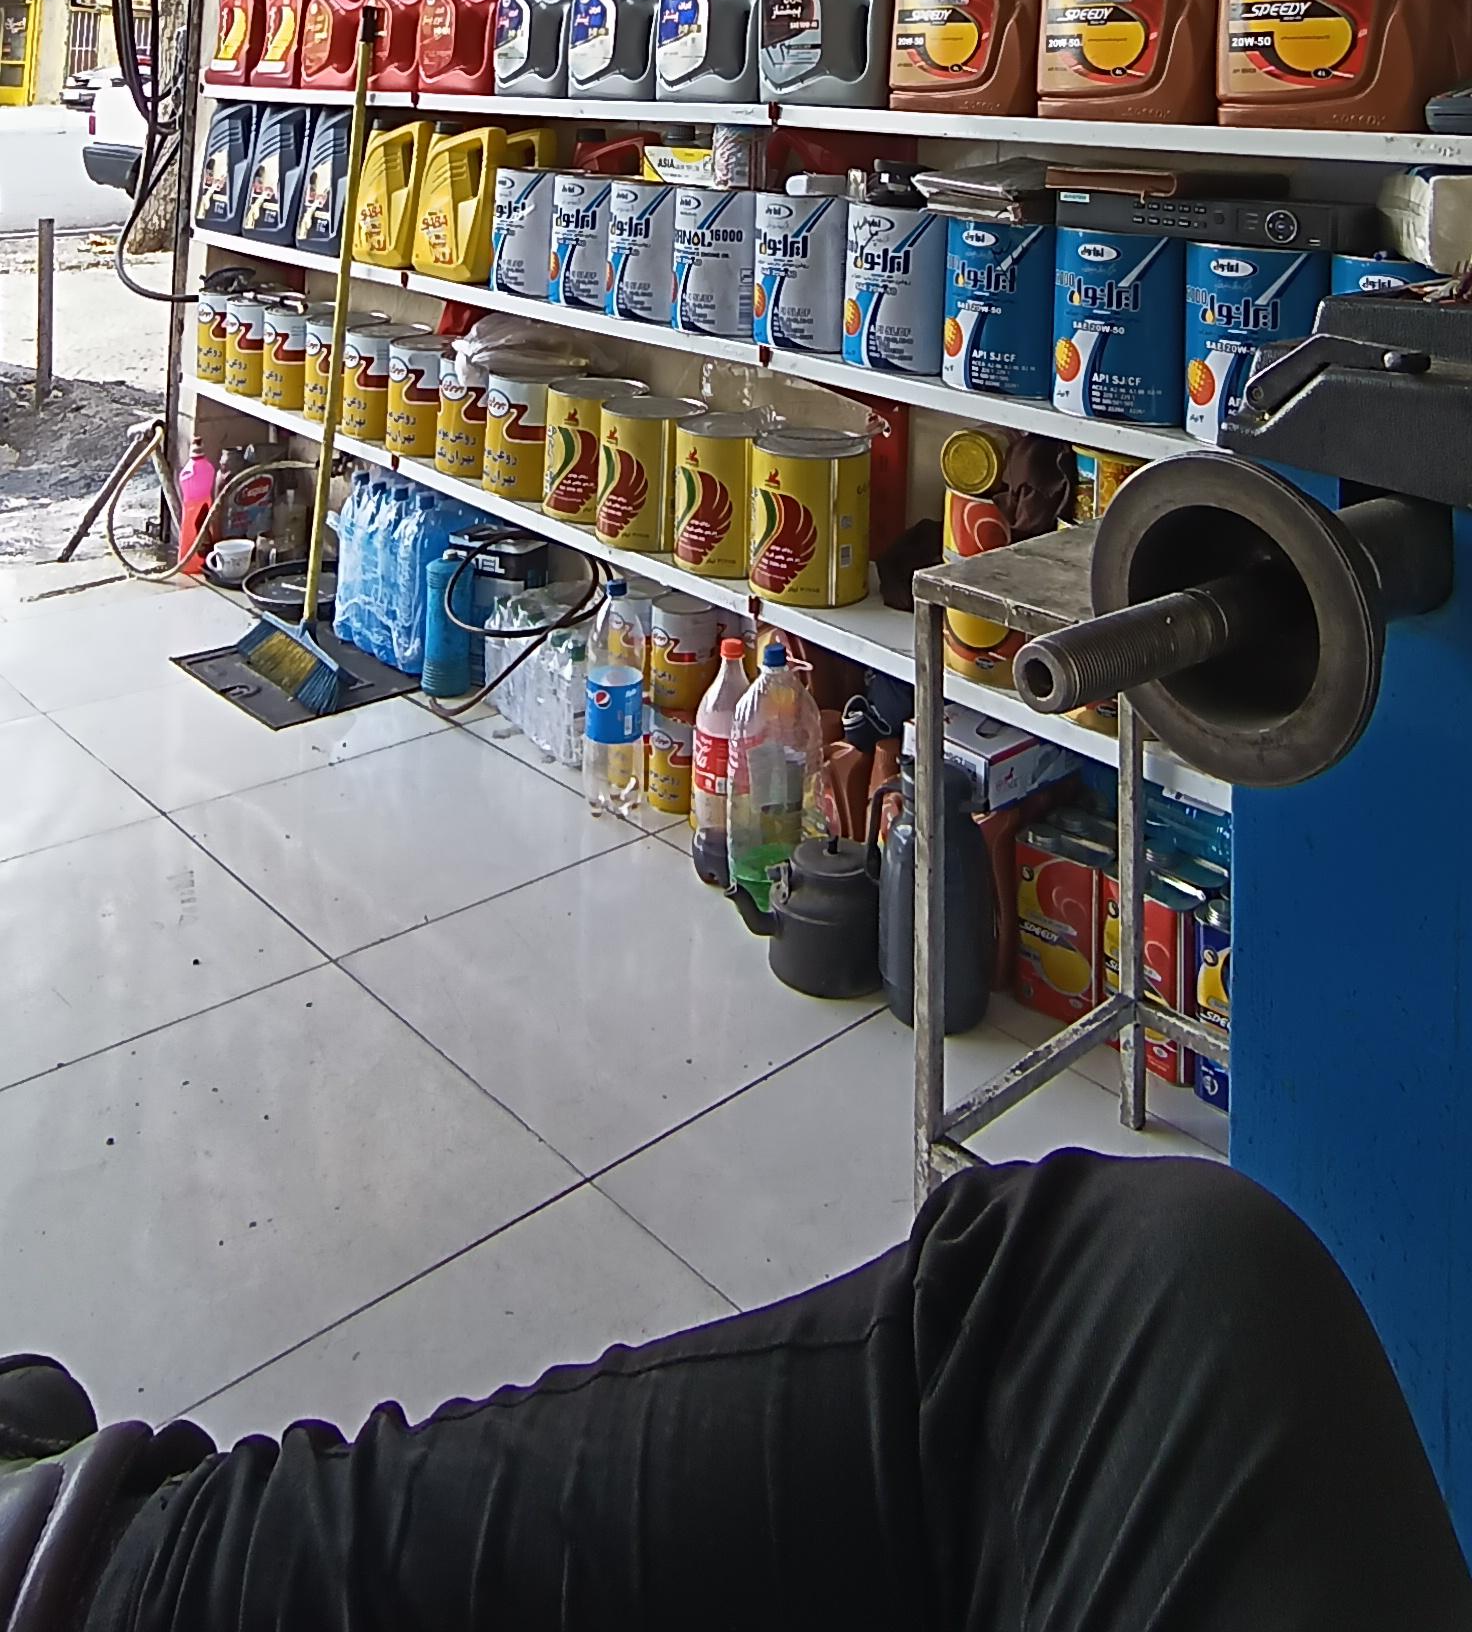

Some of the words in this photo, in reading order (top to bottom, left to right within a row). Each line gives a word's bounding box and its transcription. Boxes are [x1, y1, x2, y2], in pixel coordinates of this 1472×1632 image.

[1056, 8, 1113, 21] SPEEDY
[1241, 2, 1312, 18] SPEEDY
[1048, 38, 1080, 48] 20W-50
[1231, 36, 1271, 47] 20W-50
[657, 158, 675, 169] ASIA
[710, 229, 743, 242] 16000
[759, 230, 809, 259] ایرانول
[853, 245, 911, 275] ایرانول
[954, 260, 1018, 293] ایرانول
[1067, 276, 1142, 312] ایرانول
[1199, 294, 1280, 330] ایرانول
[1073, 321, 1088, 331] SAE
[1090, 323, 1125, 335] 20W-50
[972, 349, 987, 359] API
[1206, 341, 1222, 351] SAE
[1225, 344, 1256, 355] 20W-5
[1092, 372, 1109, 383] API
[1228, 397, 1241, 407] AP
[1200, 1011, 1231, 1029] SPE
